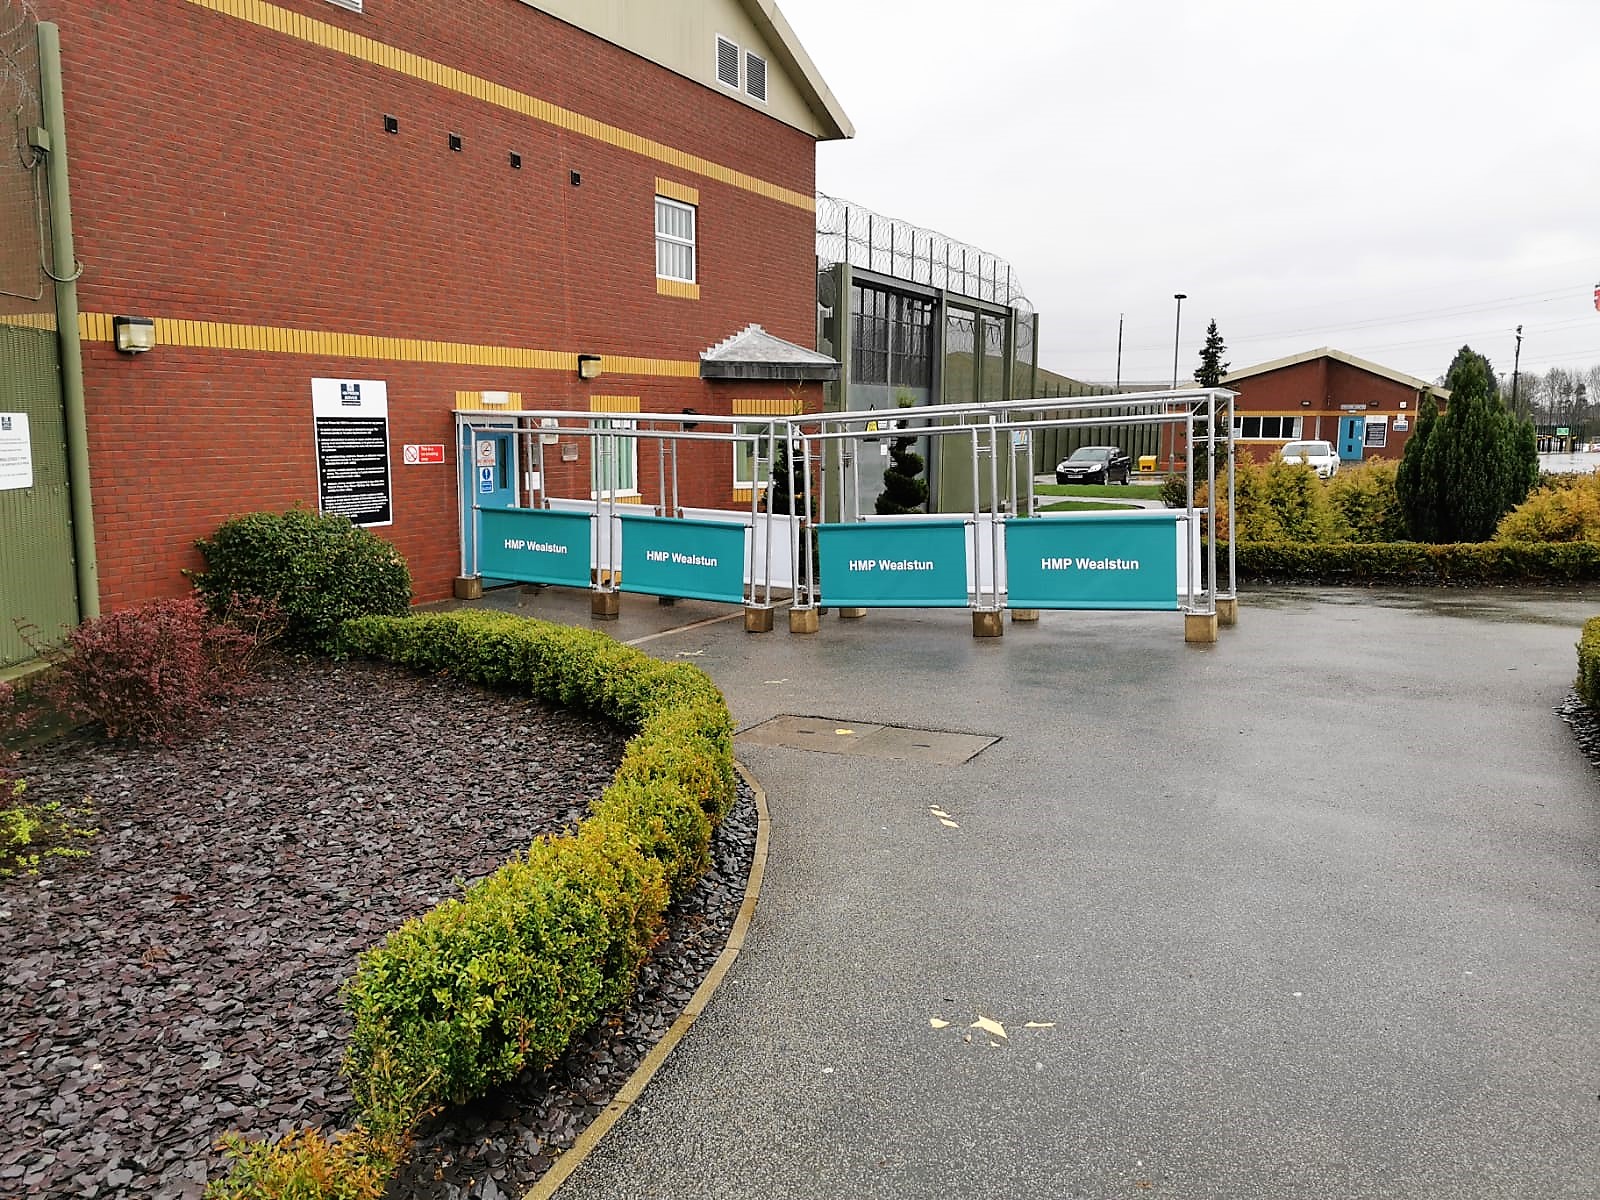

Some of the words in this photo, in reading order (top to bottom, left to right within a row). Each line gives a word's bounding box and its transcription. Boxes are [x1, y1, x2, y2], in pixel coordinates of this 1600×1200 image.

[504, 538, 525, 551] HMP
[527, 540, 567, 554] Wealstun
[646, 551, 669, 564] HMP
[671, 552, 717, 567] Wealstun
[849, 560, 875, 571] HMP
[878, 559, 933, 571] Wealstun
[1041, 558, 1071, 569] HMP
[1075, 557, 1139, 569] Wealstun
